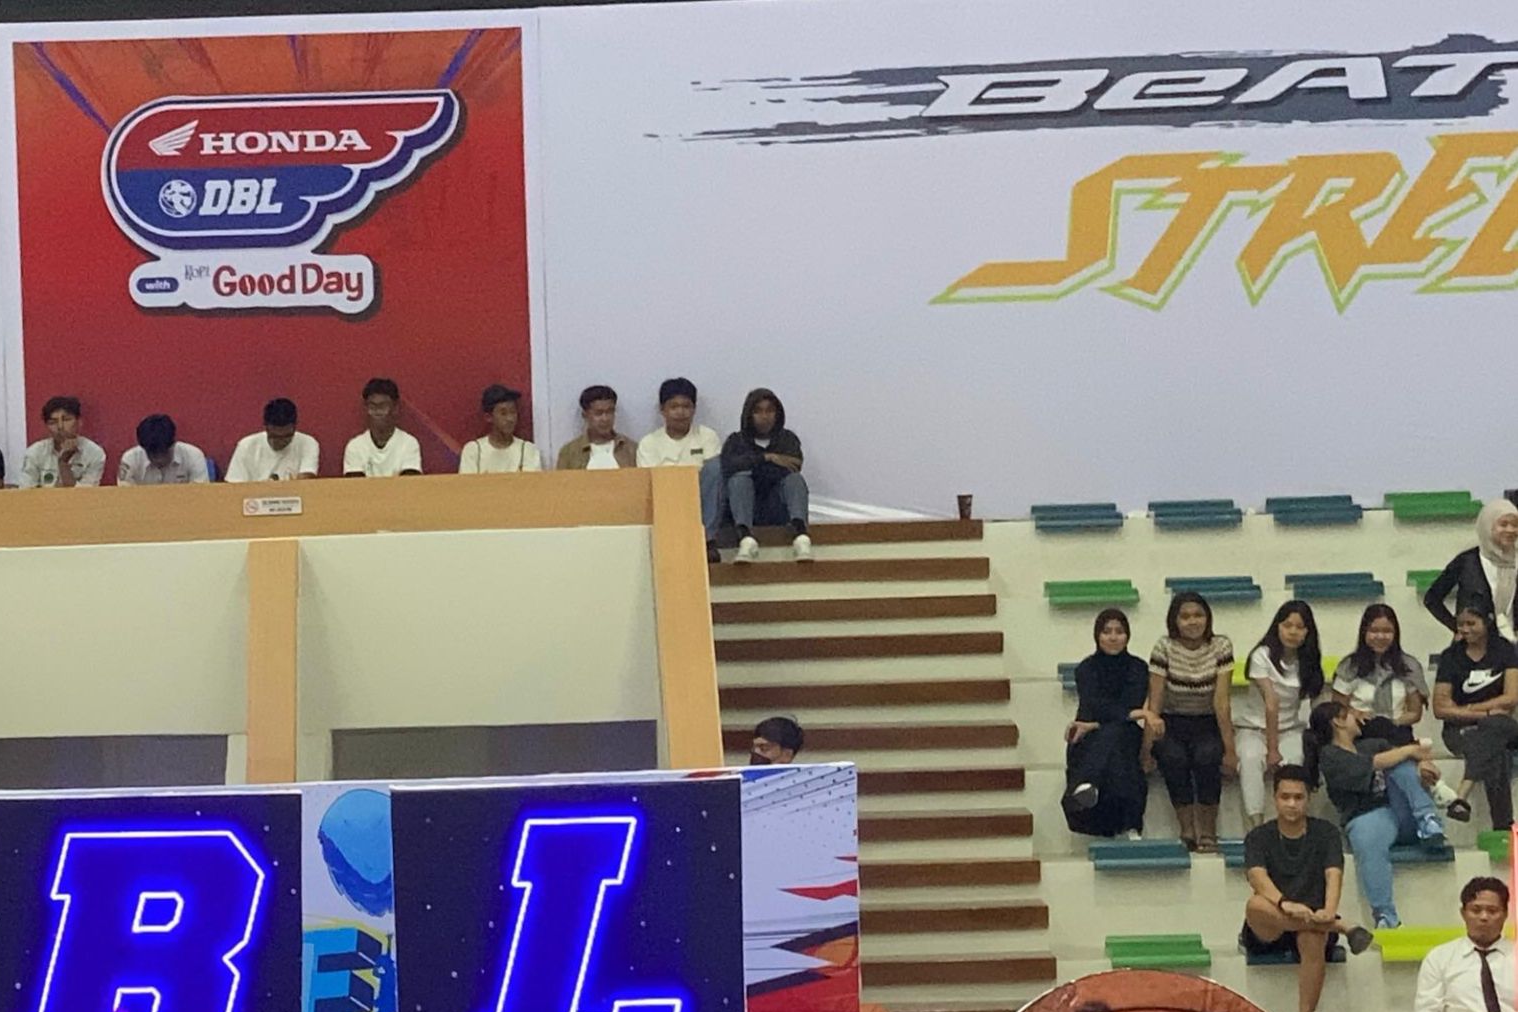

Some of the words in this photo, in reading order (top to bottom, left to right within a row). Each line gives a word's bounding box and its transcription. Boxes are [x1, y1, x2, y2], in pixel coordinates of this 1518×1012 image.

[198, 129, 371, 155] HONDA
[198, 178, 283, 216] DBL
[144, 279, 172, 291] with
